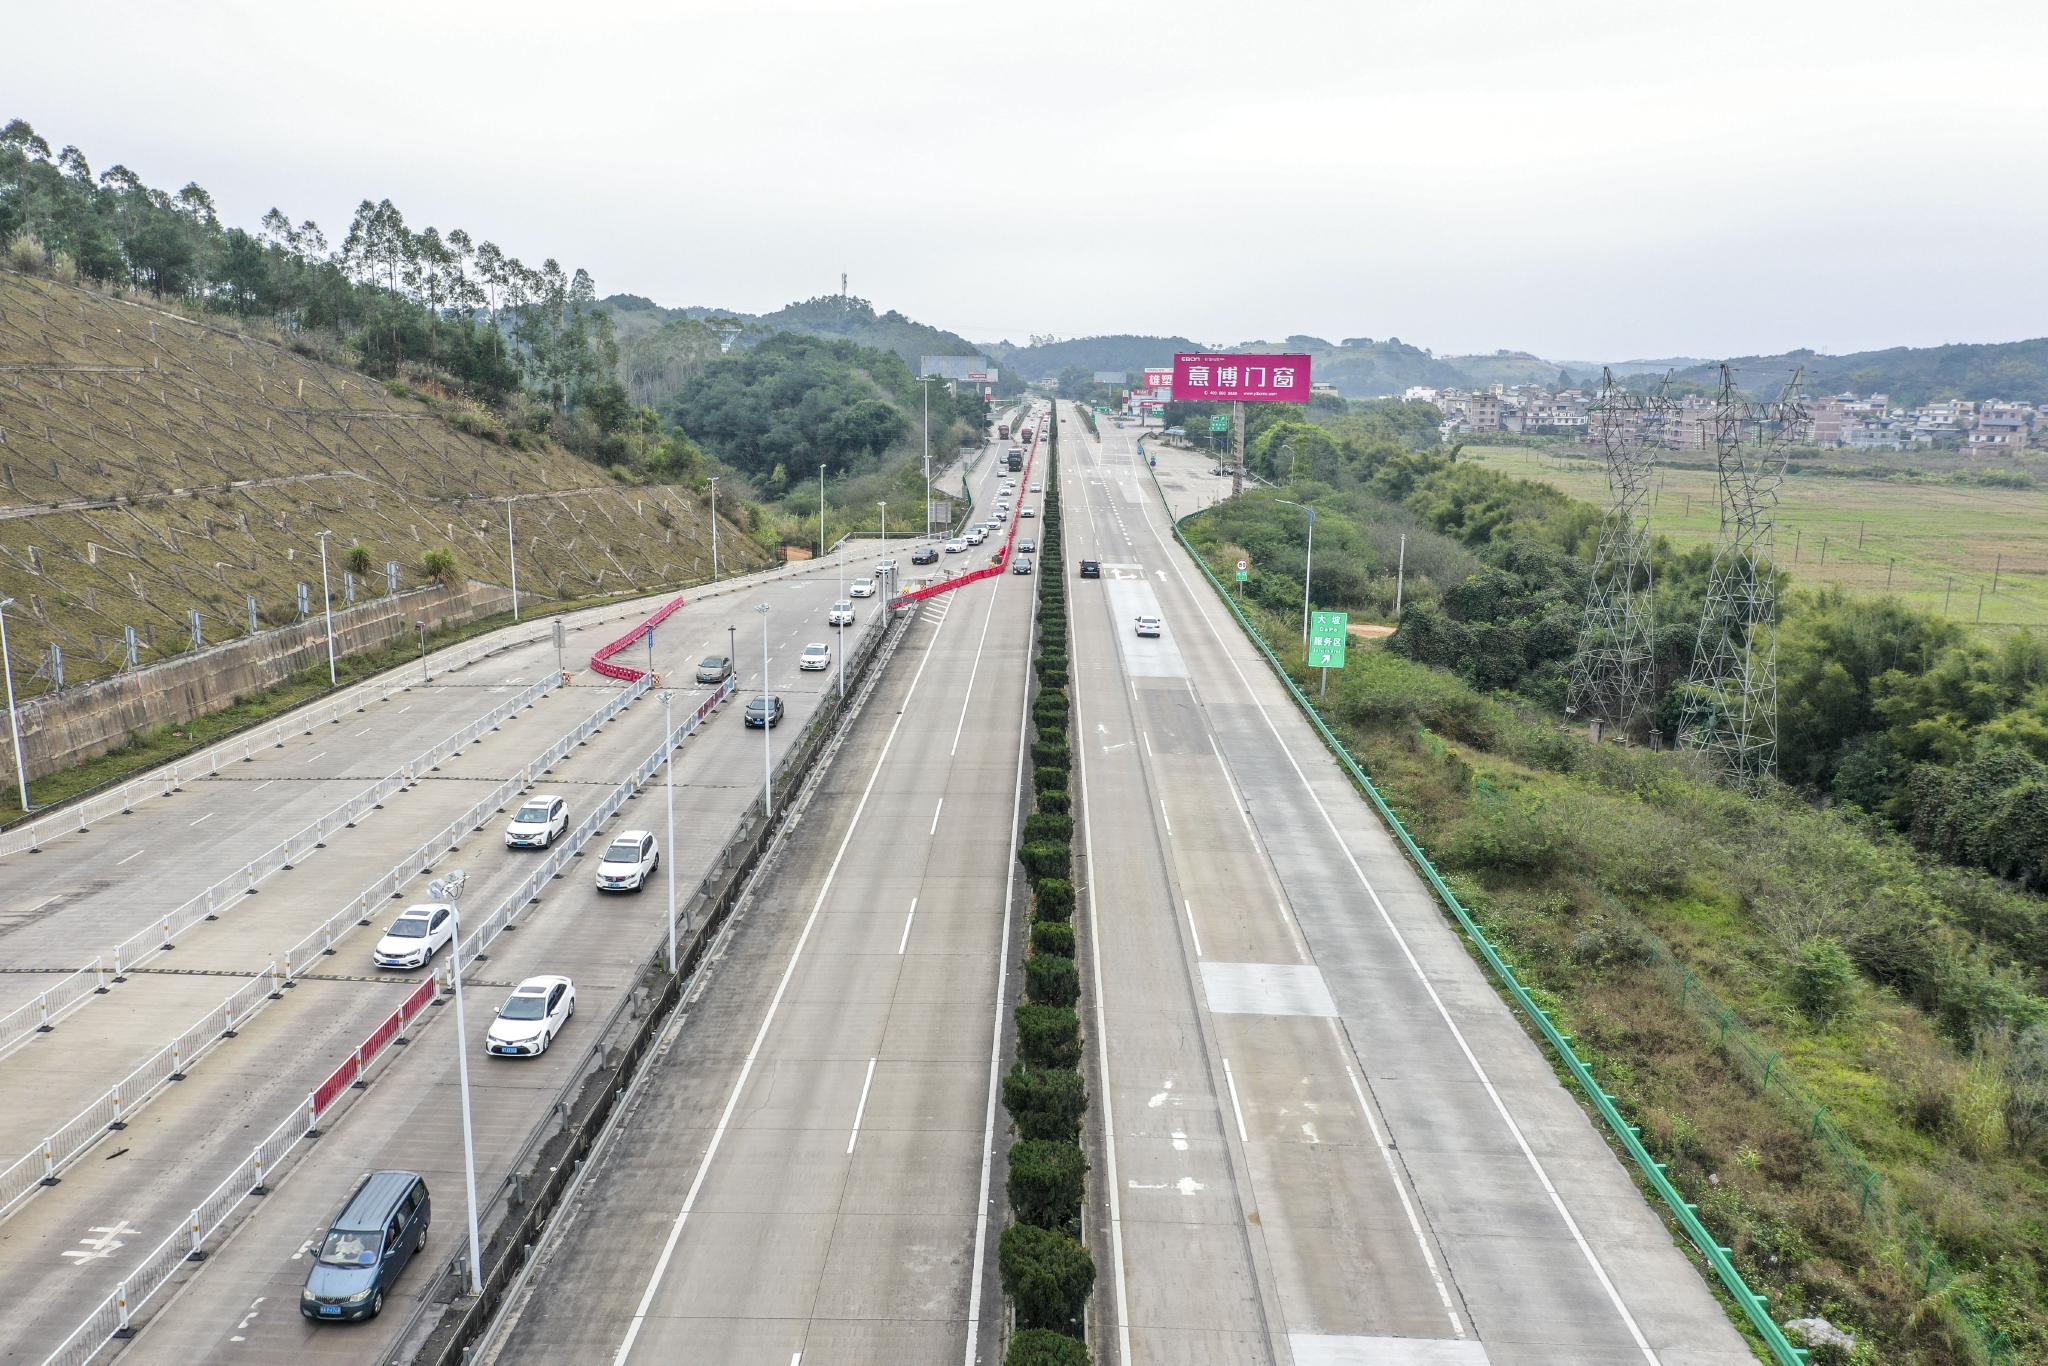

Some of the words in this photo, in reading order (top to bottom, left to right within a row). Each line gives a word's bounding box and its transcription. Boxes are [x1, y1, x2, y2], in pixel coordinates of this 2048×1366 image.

[1188, 365, 1295, 388] 意博门窗
[1314, 636, 1341, 647] 服务区
